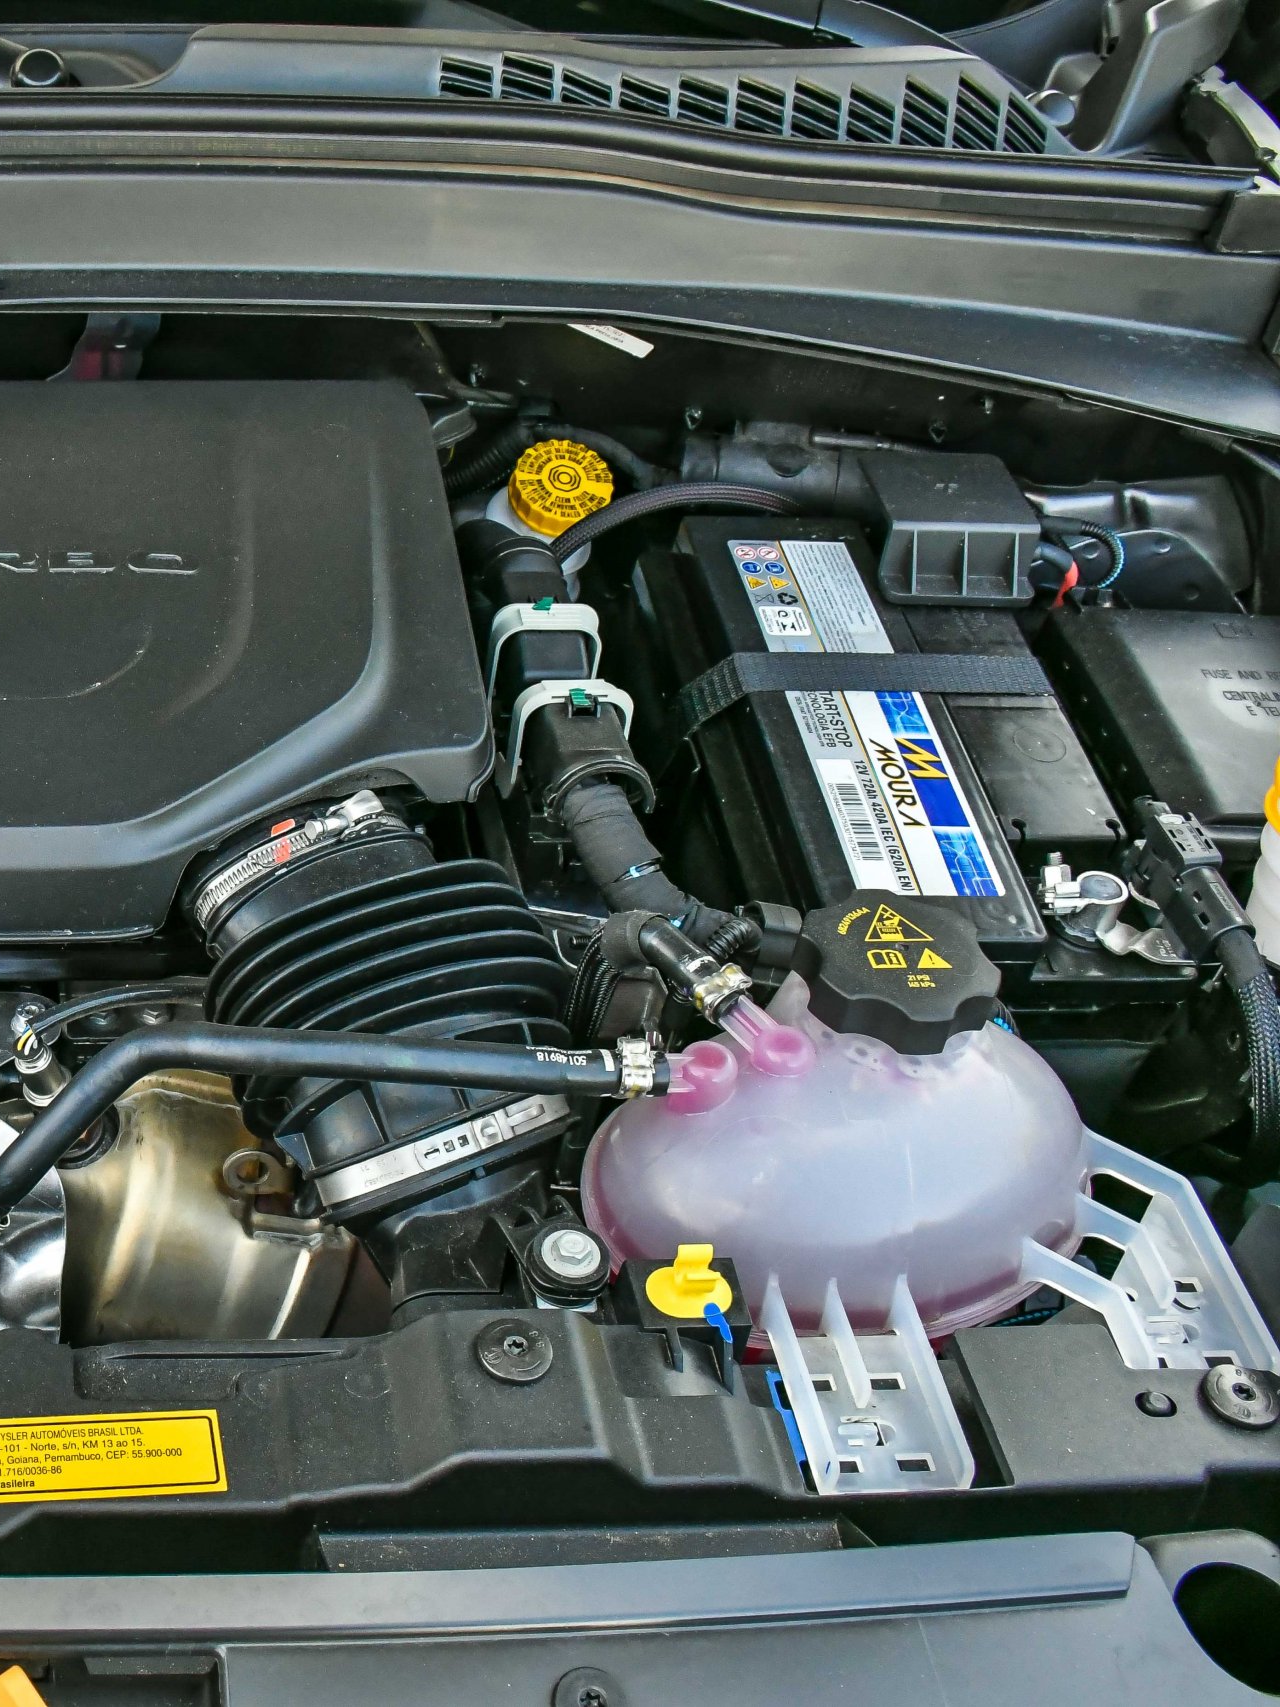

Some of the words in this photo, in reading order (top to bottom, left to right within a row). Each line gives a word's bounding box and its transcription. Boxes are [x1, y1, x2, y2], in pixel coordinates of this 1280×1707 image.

[1200, 669, 1233, 680] FUSE
[1237, 670, 1263, 681] AND
[819, 691, 853, 748] TART-STOP
[823, 733, 836, 748] EFB
[853, 759, 868, 777] 12V
[861, 778, 877, 800] 72Ah
[868, 738, 926, 826] MOURA
[871, 801, 889, 827] 420A
[879, 827, 895, 842] IEC
[885, 843, 905, 874] (620A
[896, 876, 916, 893] EN)
[536, 1052, 587, 1066] 50148918
[30, 1428, 86, 1440] AUTOMÓVEIS
[88, 1428, 118, 1437] BRASIL
[120, 1427, 144, 1436] LTDA.
[30, 1442, 59, 1452] Norte,
[62, 1442, 79, 1450] s/n,
[82, 1440, 98, 1448] KM
[102, 1440, 113, 1448] 13
[132, 1438, 145, 1447] 15.
[6, 1455, 42, 1465] Goiana,
[44, 1452, 104, 1462] Pernambuco,
[106, 1450, 129, 1459] CEP:
[132, 1448, 182, 1458] 55.900-000
